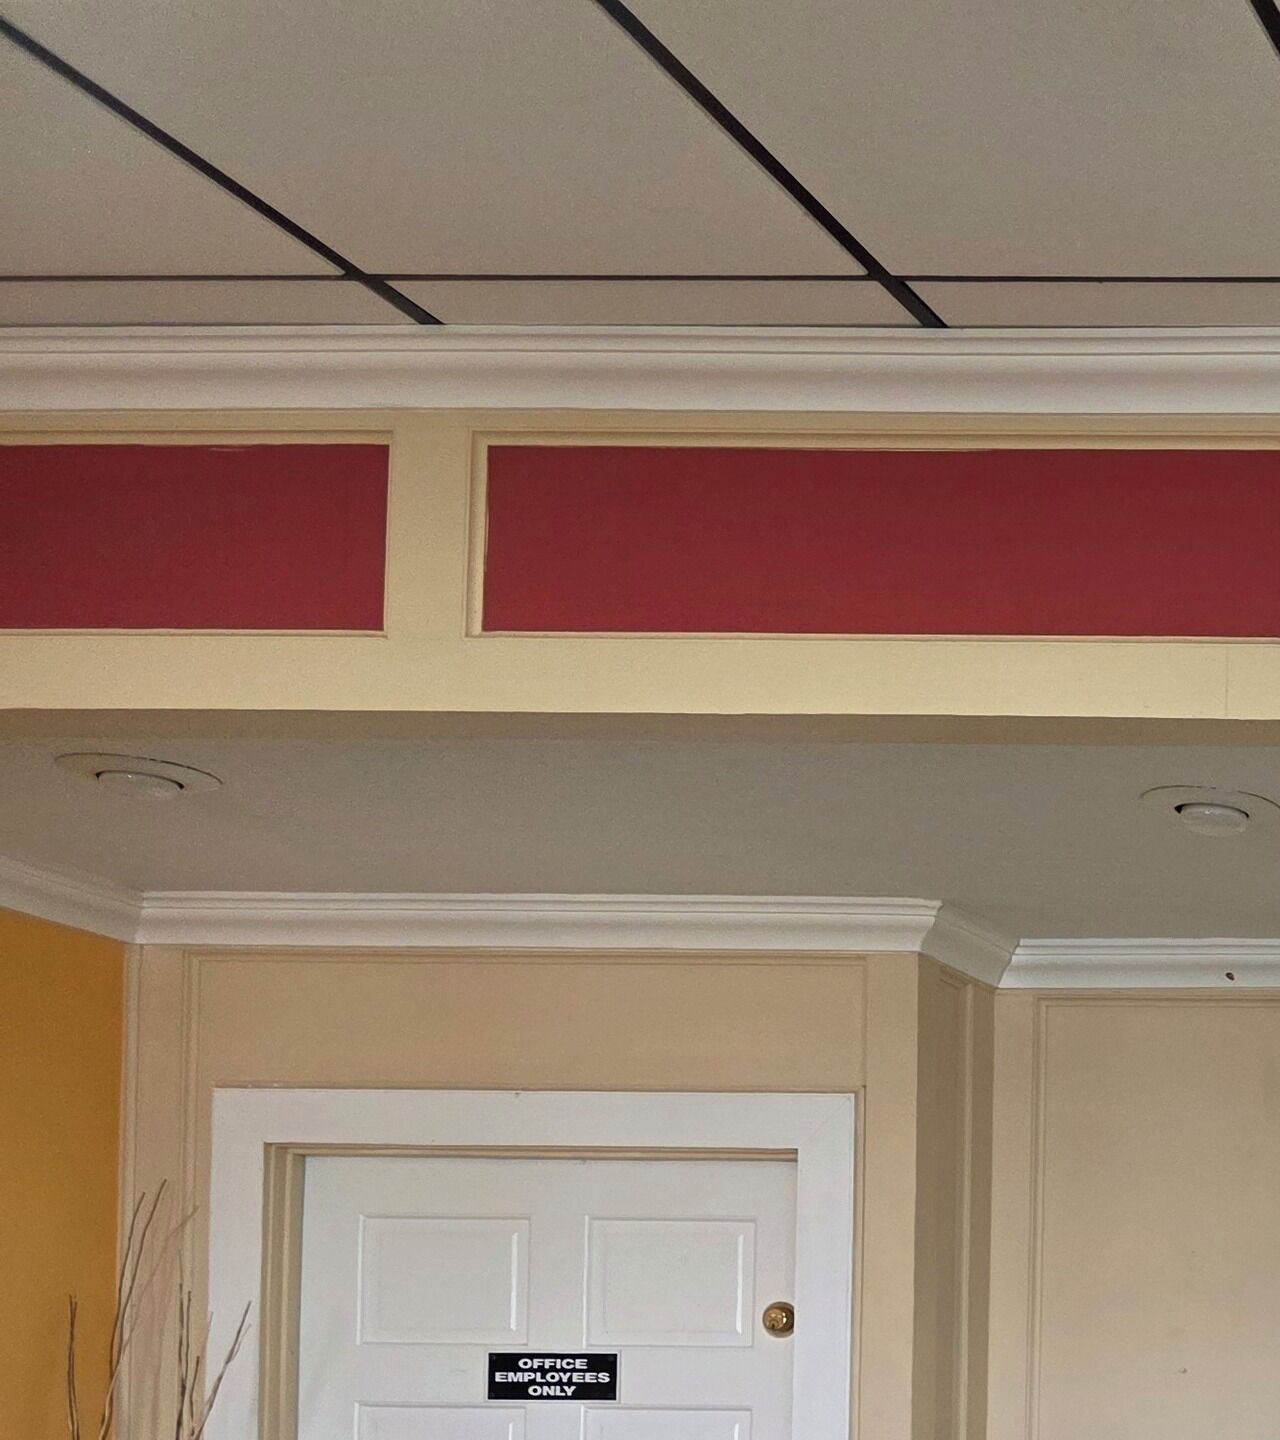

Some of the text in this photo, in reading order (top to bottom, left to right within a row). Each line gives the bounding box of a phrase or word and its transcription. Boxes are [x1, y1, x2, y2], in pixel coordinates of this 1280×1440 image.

[518, 1358, 588, 1369] OFFICE
[495, 1372, 610, 1383] EMPLOYEES
[528, 1385, 576, 1396] ONLY
